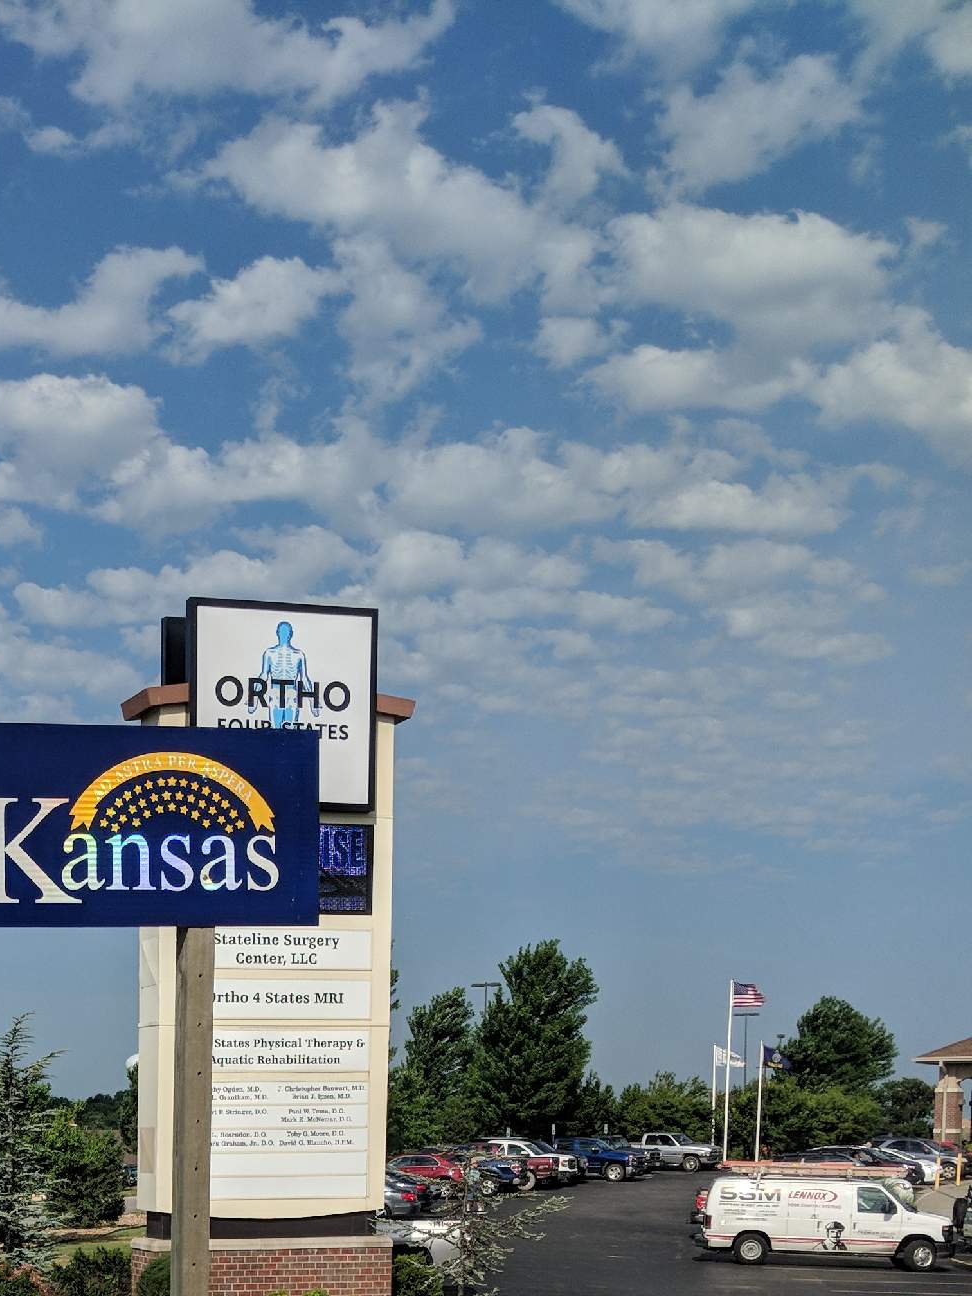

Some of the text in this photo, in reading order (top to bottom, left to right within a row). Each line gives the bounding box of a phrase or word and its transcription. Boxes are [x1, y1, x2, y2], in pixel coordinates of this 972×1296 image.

[215, 675, 351, 712] ORTHO
[116, 758, 163, 783] ASTRA
[168, 755, 197, 770] PER
[202, 763, 253, 801] ASPERA
[214, 933, 340, 949] Stateline Surgery
[235, 952, 318, 966] Center, LLC
[253, 992, 261, 1003] 4
[265, 992, 310, 1004] States
[314, 992, 344, 1004] MRI
[214, 1038, 366, 1051] States Physical Therapy &
[257, 1055, 340, 1065] Rehabilitation
[788, 1190, 829, 1201] LENNOX
